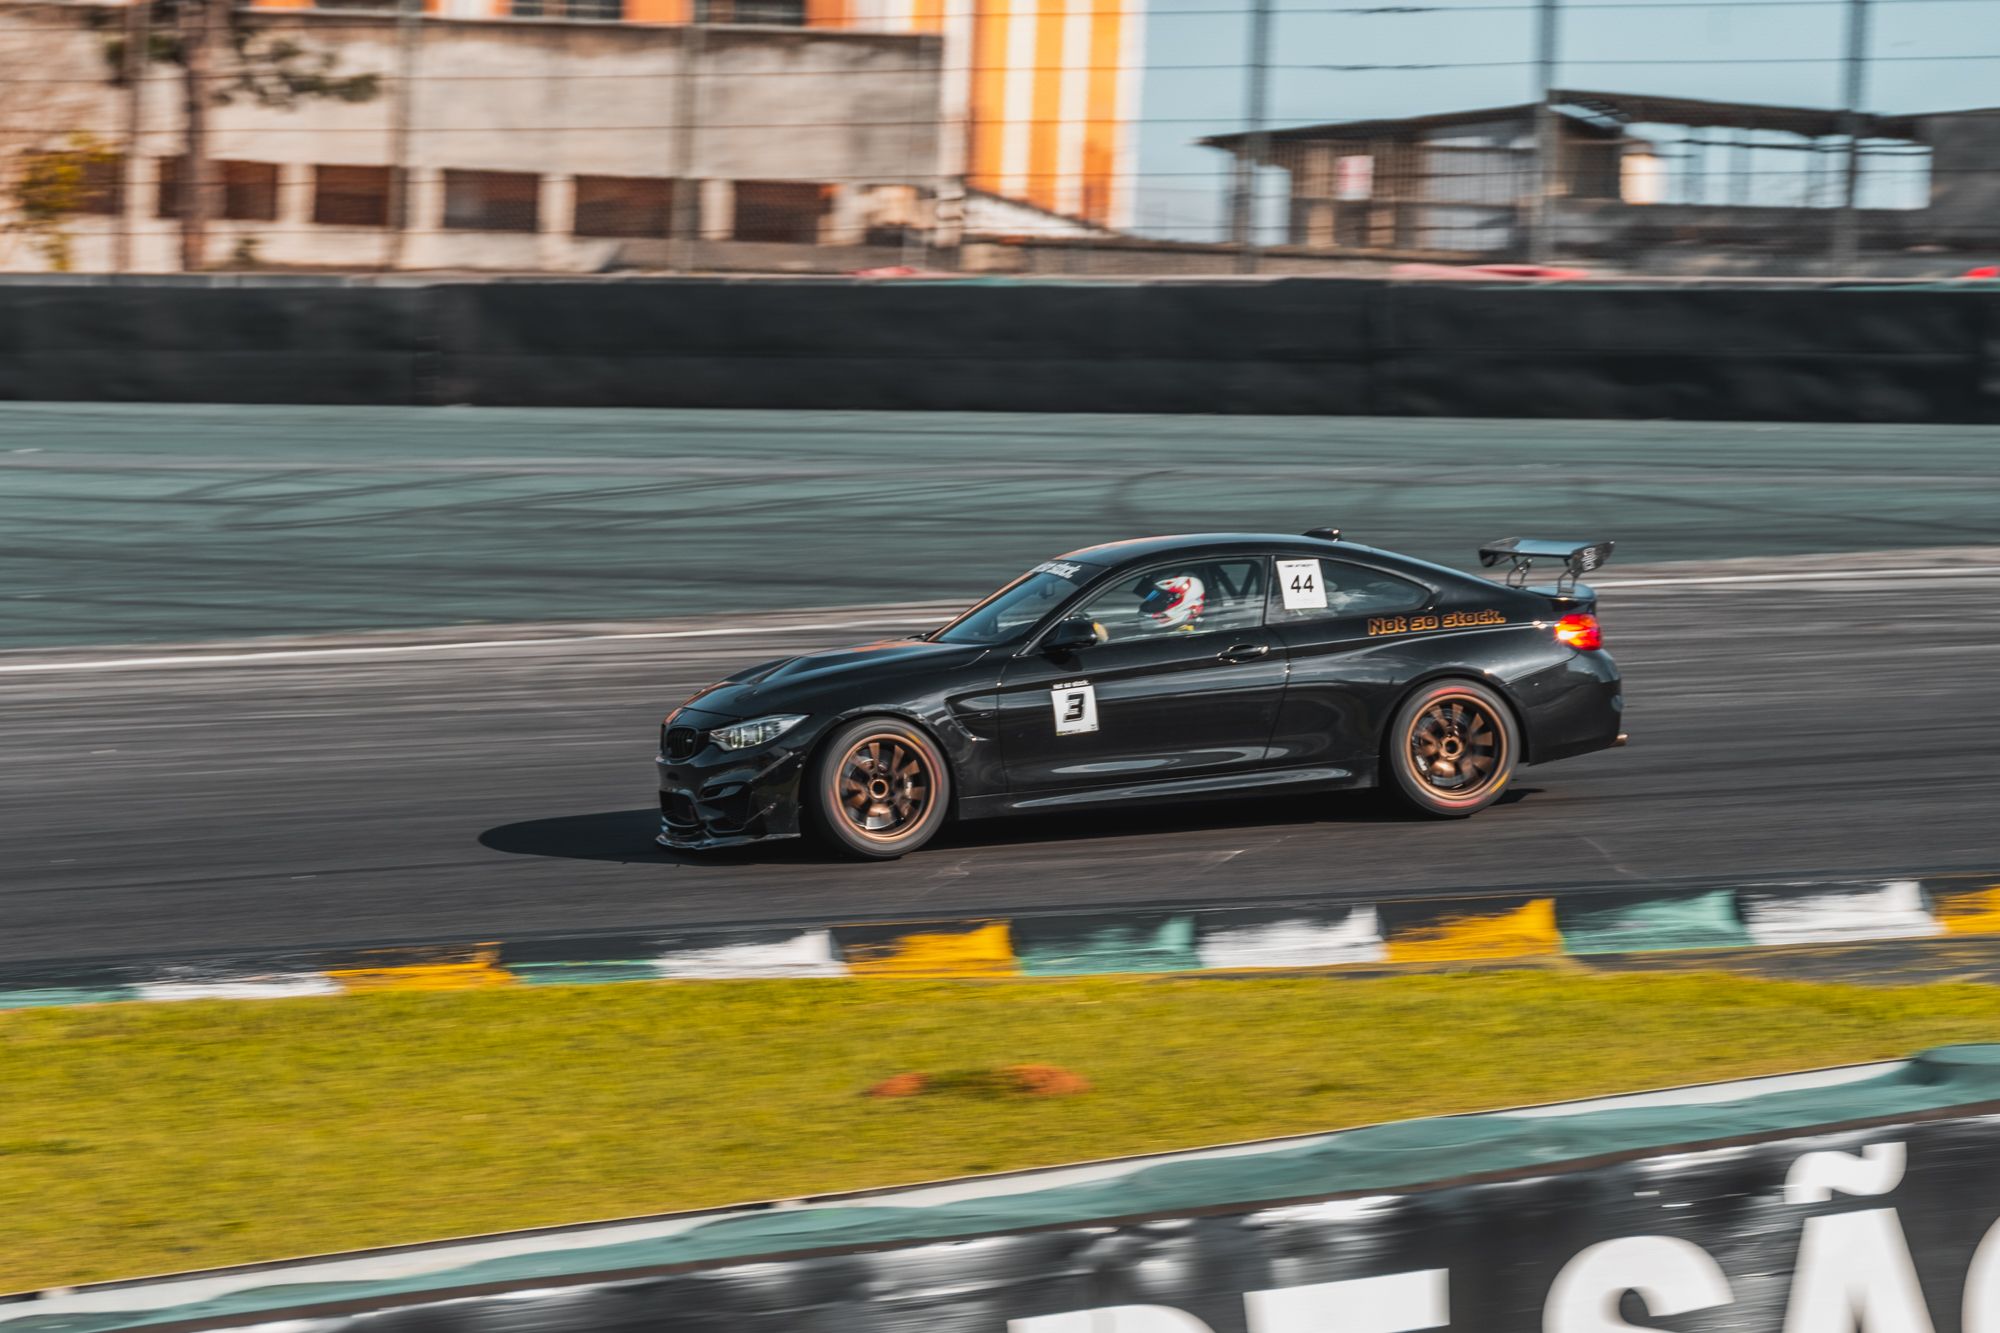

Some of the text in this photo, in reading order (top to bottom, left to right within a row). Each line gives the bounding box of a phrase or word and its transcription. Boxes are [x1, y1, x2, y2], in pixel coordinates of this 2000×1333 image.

[1290, 574, 1314, 593] 44
[1368, 616, 1407, 635] Not
[1063, 691, 1086, 723] 3
